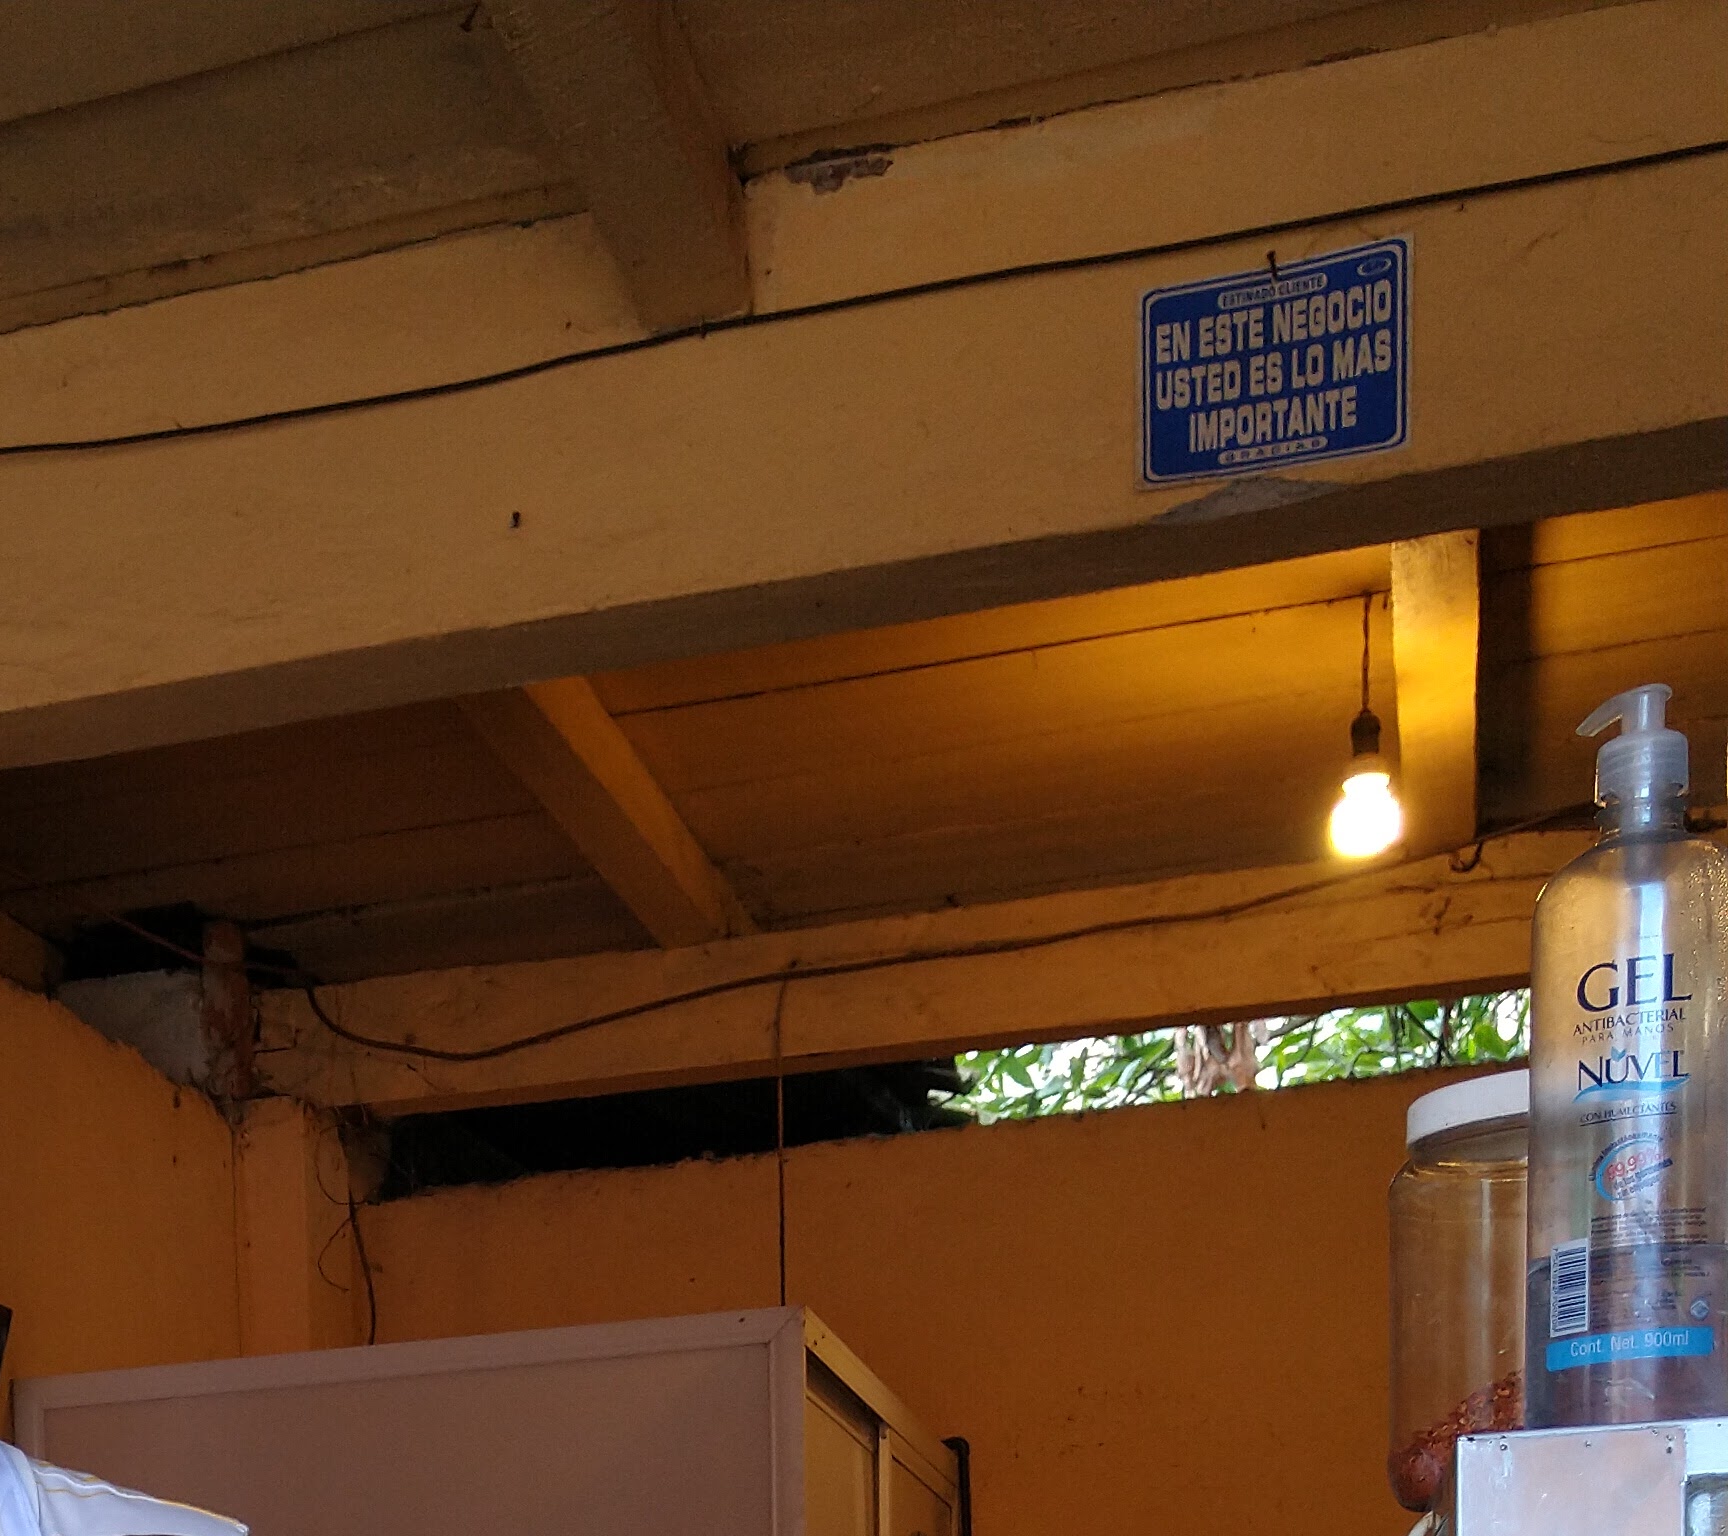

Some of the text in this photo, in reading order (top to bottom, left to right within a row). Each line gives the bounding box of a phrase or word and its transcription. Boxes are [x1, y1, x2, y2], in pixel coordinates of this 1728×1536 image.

[1156, 279, 1392, 365] EN ESTE NEGOCIO
[1155, 328, 1392, 411] USTED ES LO MAS
[1189, 385, 1357, 453] IMPORTANTE
[1576, 953, 1693, 1013] GEL
[1572, 1008, 1687, 1037] ANTIBACTERIAL
[1581, 1023, 1675, 1046] PARA MANOS
[1570, 1338, 1601, 1357] Cont
